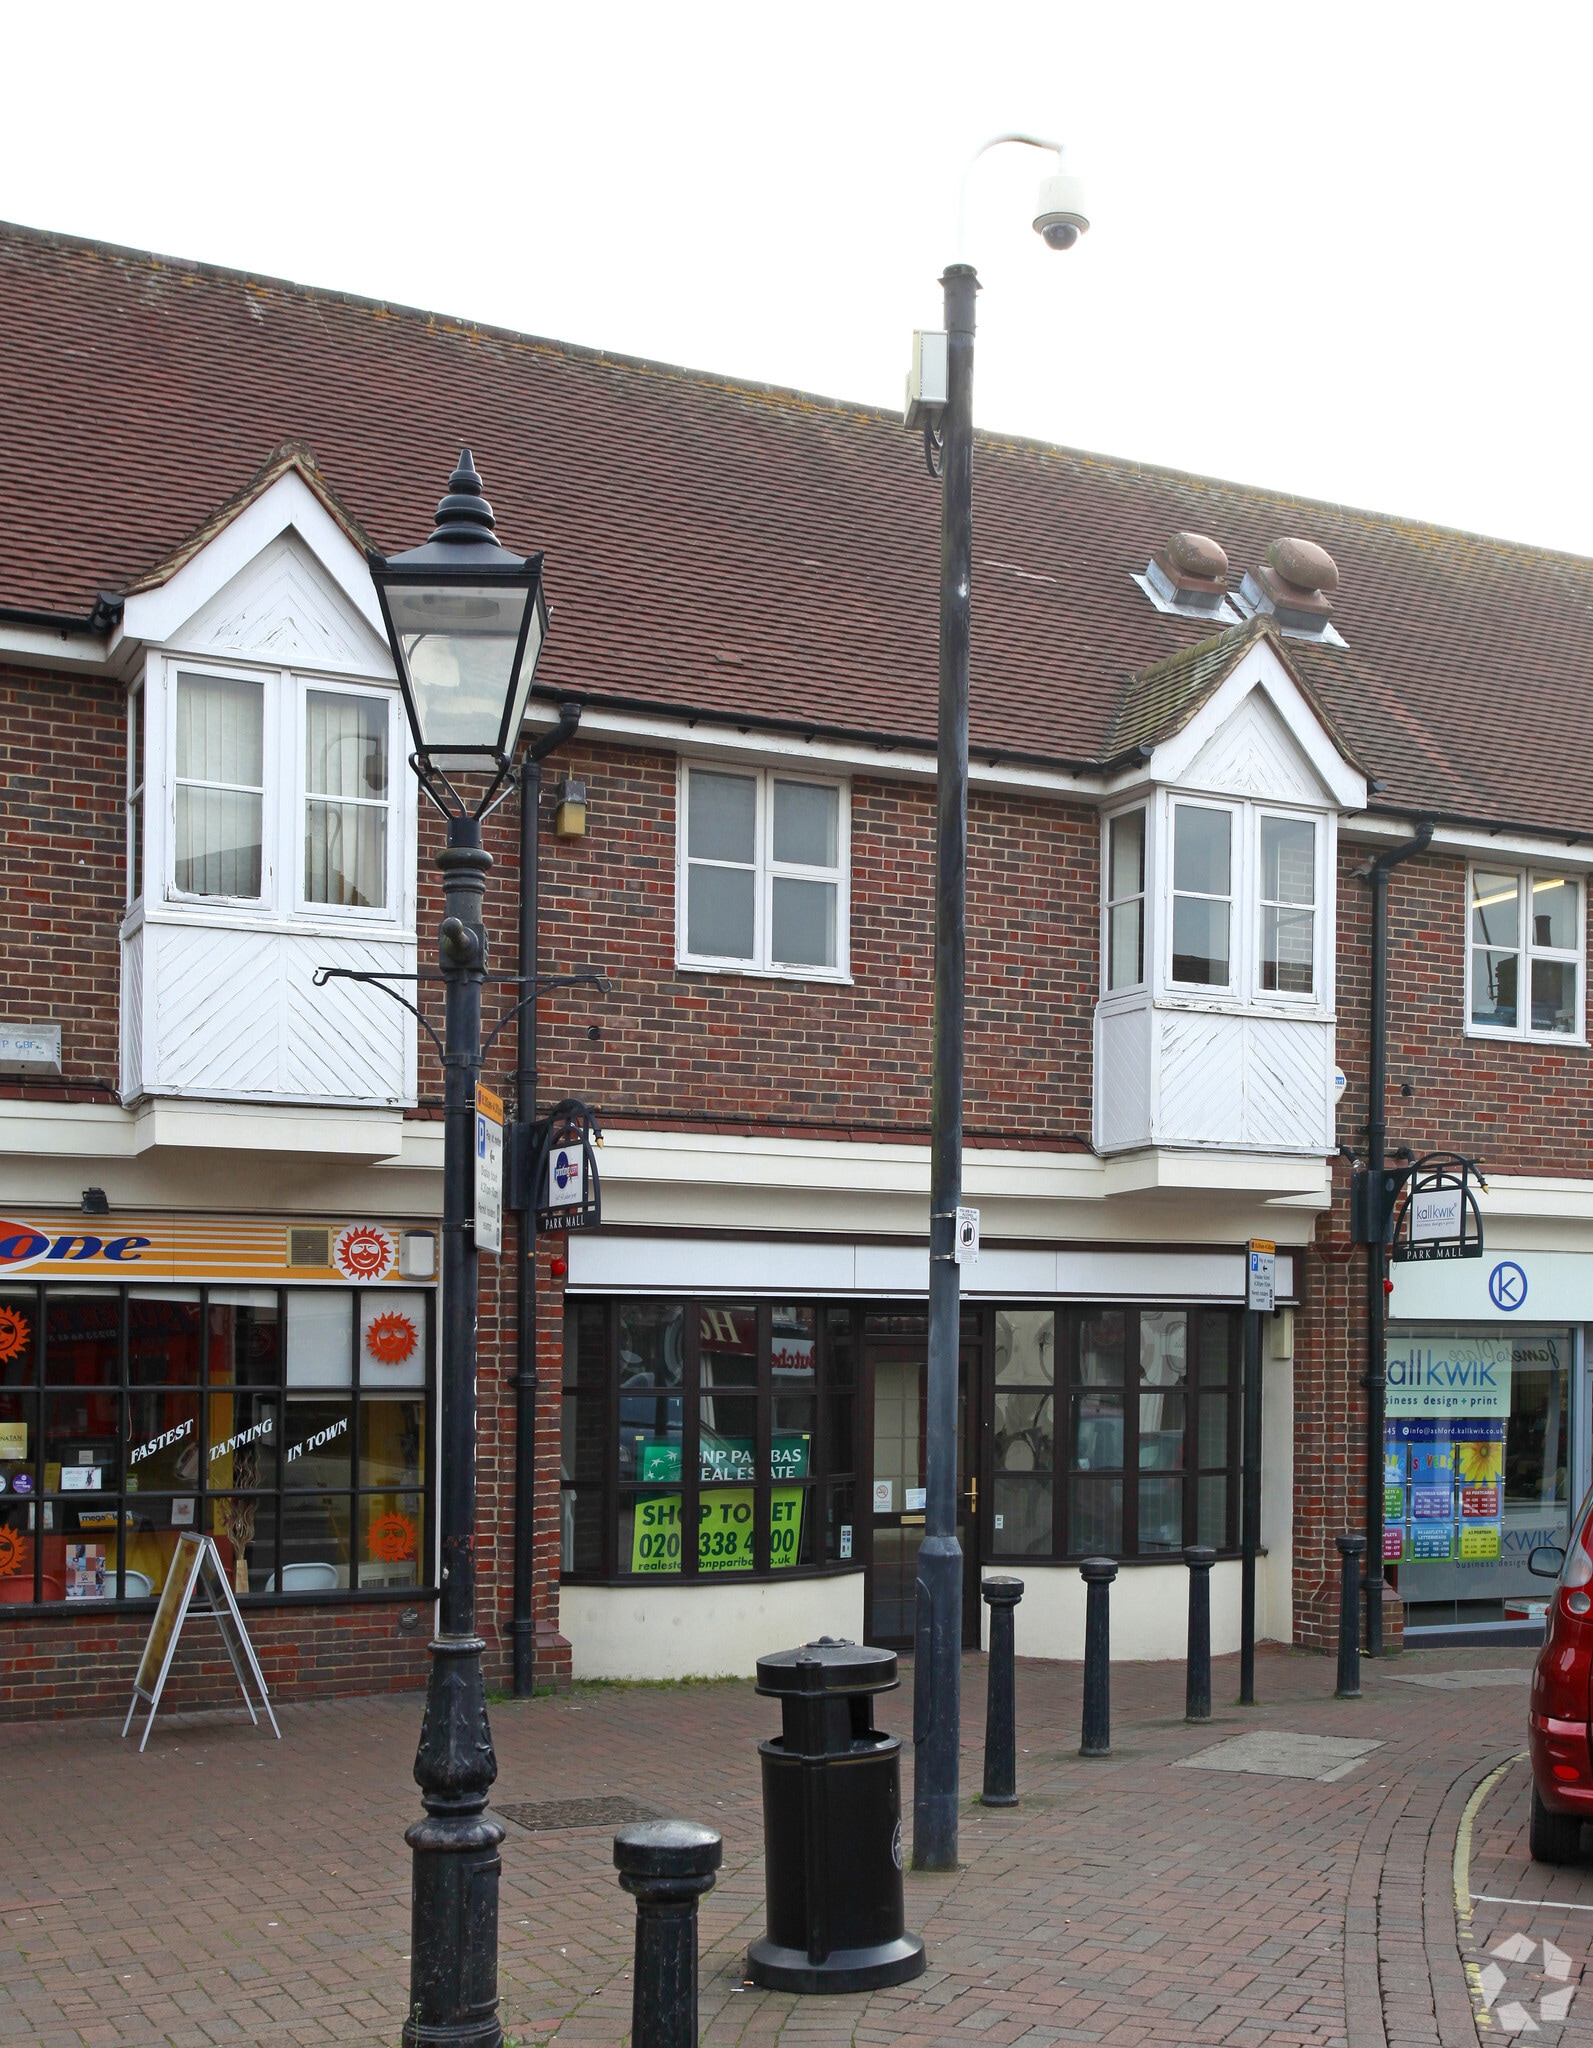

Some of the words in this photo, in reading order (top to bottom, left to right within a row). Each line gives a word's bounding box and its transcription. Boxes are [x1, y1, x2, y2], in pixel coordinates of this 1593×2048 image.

[1416, 1204, 1455, 1220] kallkwik
[545, 1217, 563, 1230] PARK
[565, 1215, 585, 1227] MALL
[1406, 1250, 1431, 1260] PARK
[1436, 1247, 1464, 1258] MALL
[1386, 1395, 1418, 1405] siness
[1423, 1395, 1458, 1407] design
[1470, 1396, 1498, 1407] print
[130, 1418, 194, 1465] FASTEST
[209, 1418, 273, 1462] TANNING
[286, 1443, 303, 1464] IN
[306, 1418, 348, 1452] TOWN
[699, 1449, 727, 1464] NP
[731, 1449, 802, 1464] PABAS
[1413, 1454, 1453, 1470] SAVERS
[701, 1467, 734, 1481] EAL
[737, 1465, 796, 1480] ESATE
[720, 1503, 752, 1524] TO
[772, 1501, 797, 1522] ET
[639, 1532, 681, 1559] 020
[699, 1531, 738, 1557] 338
[744, 1528, 796, 1555] 400
[1456, 1561, 1494, 1569] business
[1498, 1559, 1526, 1568] design
